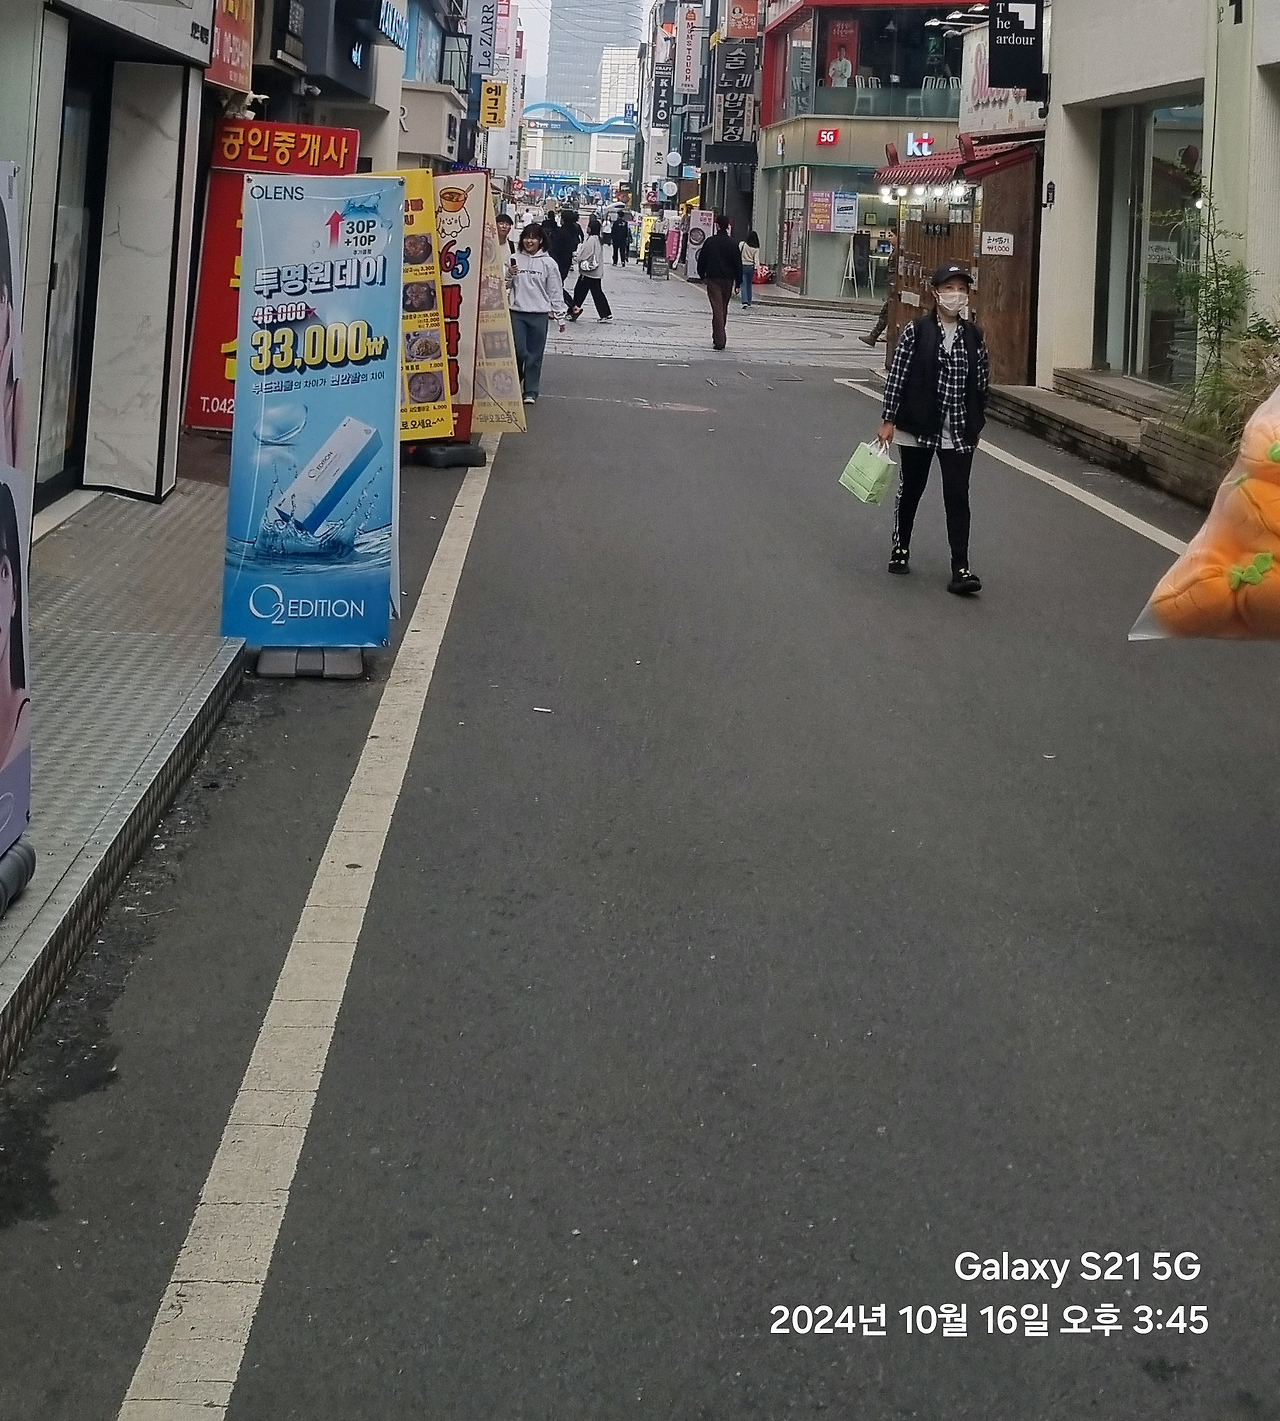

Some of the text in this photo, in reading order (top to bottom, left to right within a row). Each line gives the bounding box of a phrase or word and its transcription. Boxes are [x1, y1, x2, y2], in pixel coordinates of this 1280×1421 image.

[996, 32, 1036, 47] ardour
[718, 73, 752, 89] 노래
[656, 78, 669, 121] KITO
[722, 91, 746, 143] 압구정
[820, 131, 834, 142] 5G
[906, 132, 934, 157] kt
[221, 126, 349, 169] 공인중개사
[250, 185, 305, 201] OLENS
[345, 219, 377, 235] 30P
[344, 234, 377, 247] +10P
[254, 255, 388, 297] 투명원데이
[370, 371, 386, 381] 차이
[287, 598, 365, 618] EDITION
